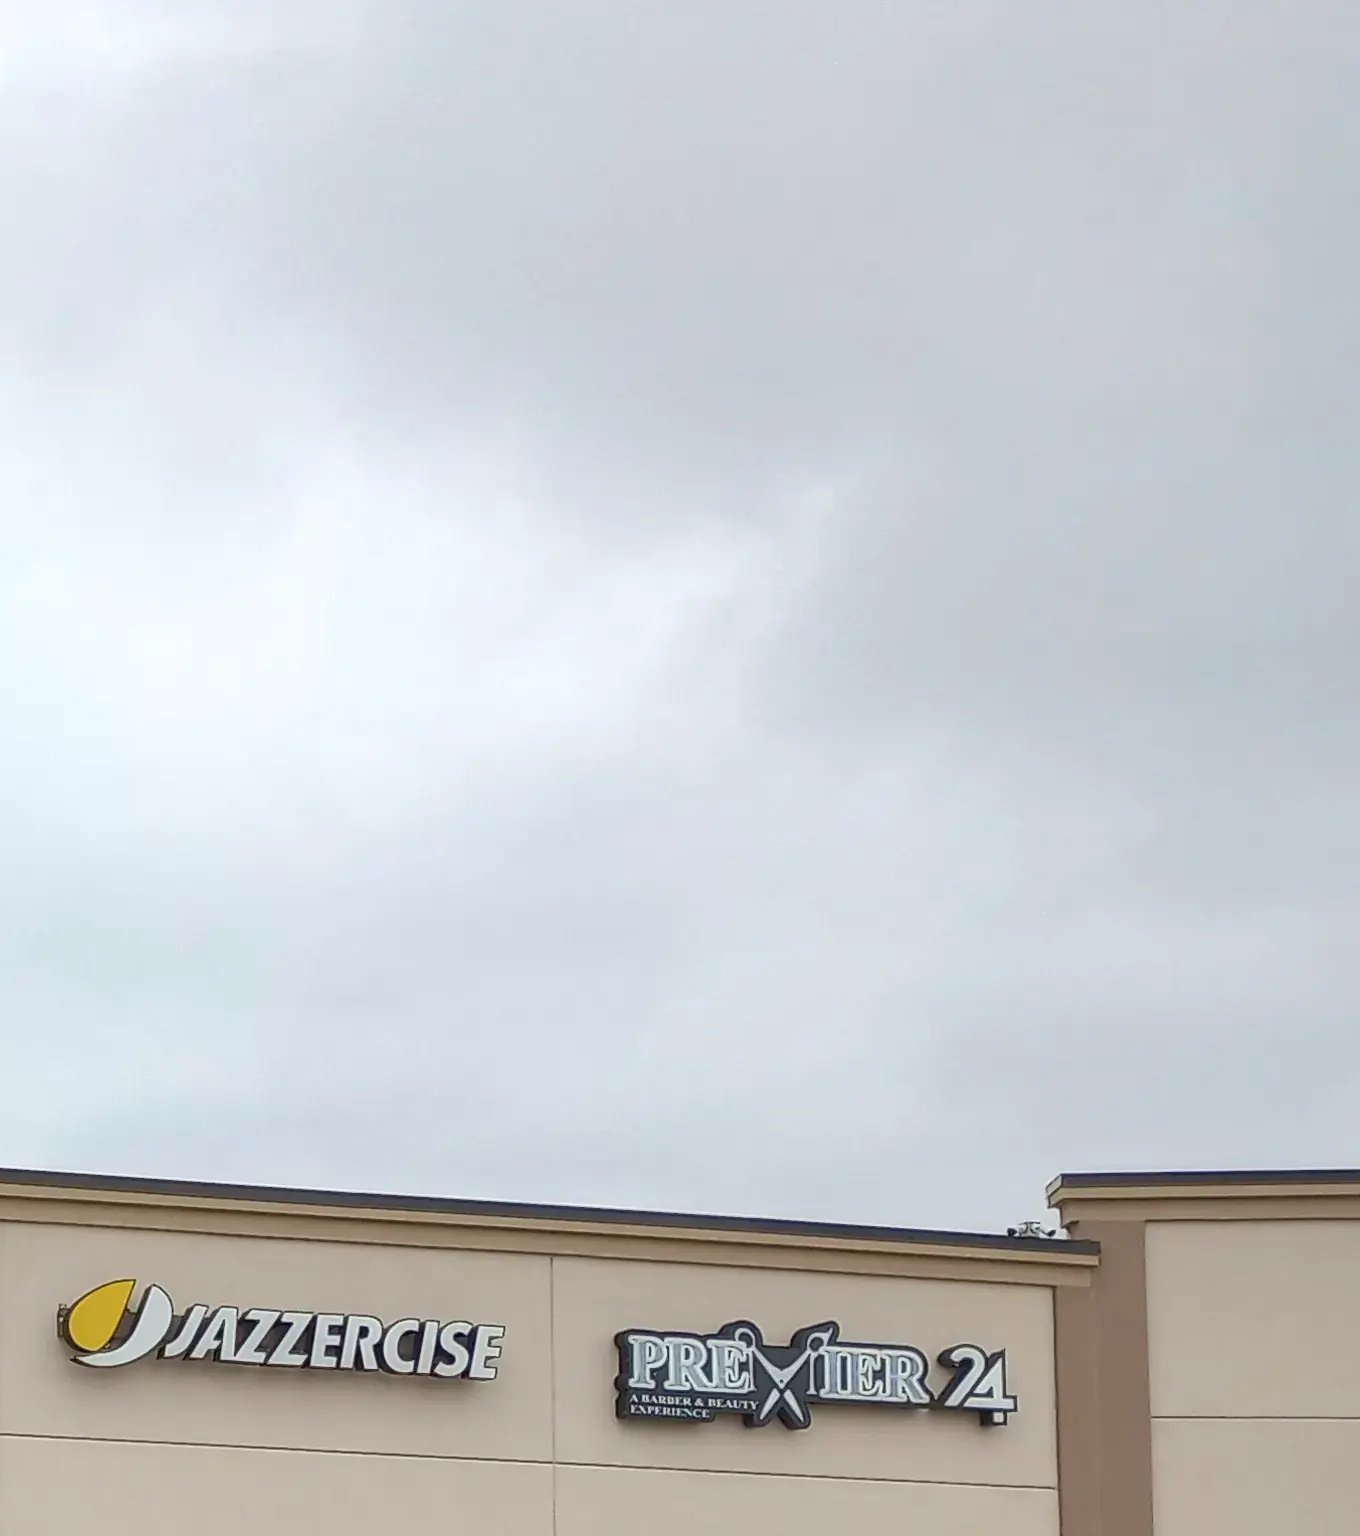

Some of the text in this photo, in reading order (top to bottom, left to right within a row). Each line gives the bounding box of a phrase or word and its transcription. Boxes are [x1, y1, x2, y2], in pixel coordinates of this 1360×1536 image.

[164, 1303, 505, 1380] JAZZERCISE
[641, 1394, 692, 1406] BARBER
[708, 1399, 759, 1410] BEAUTY
[944, 1347, 1016, 1423] 24
[630, 1404, 710, 1418] EXPERIENCE
